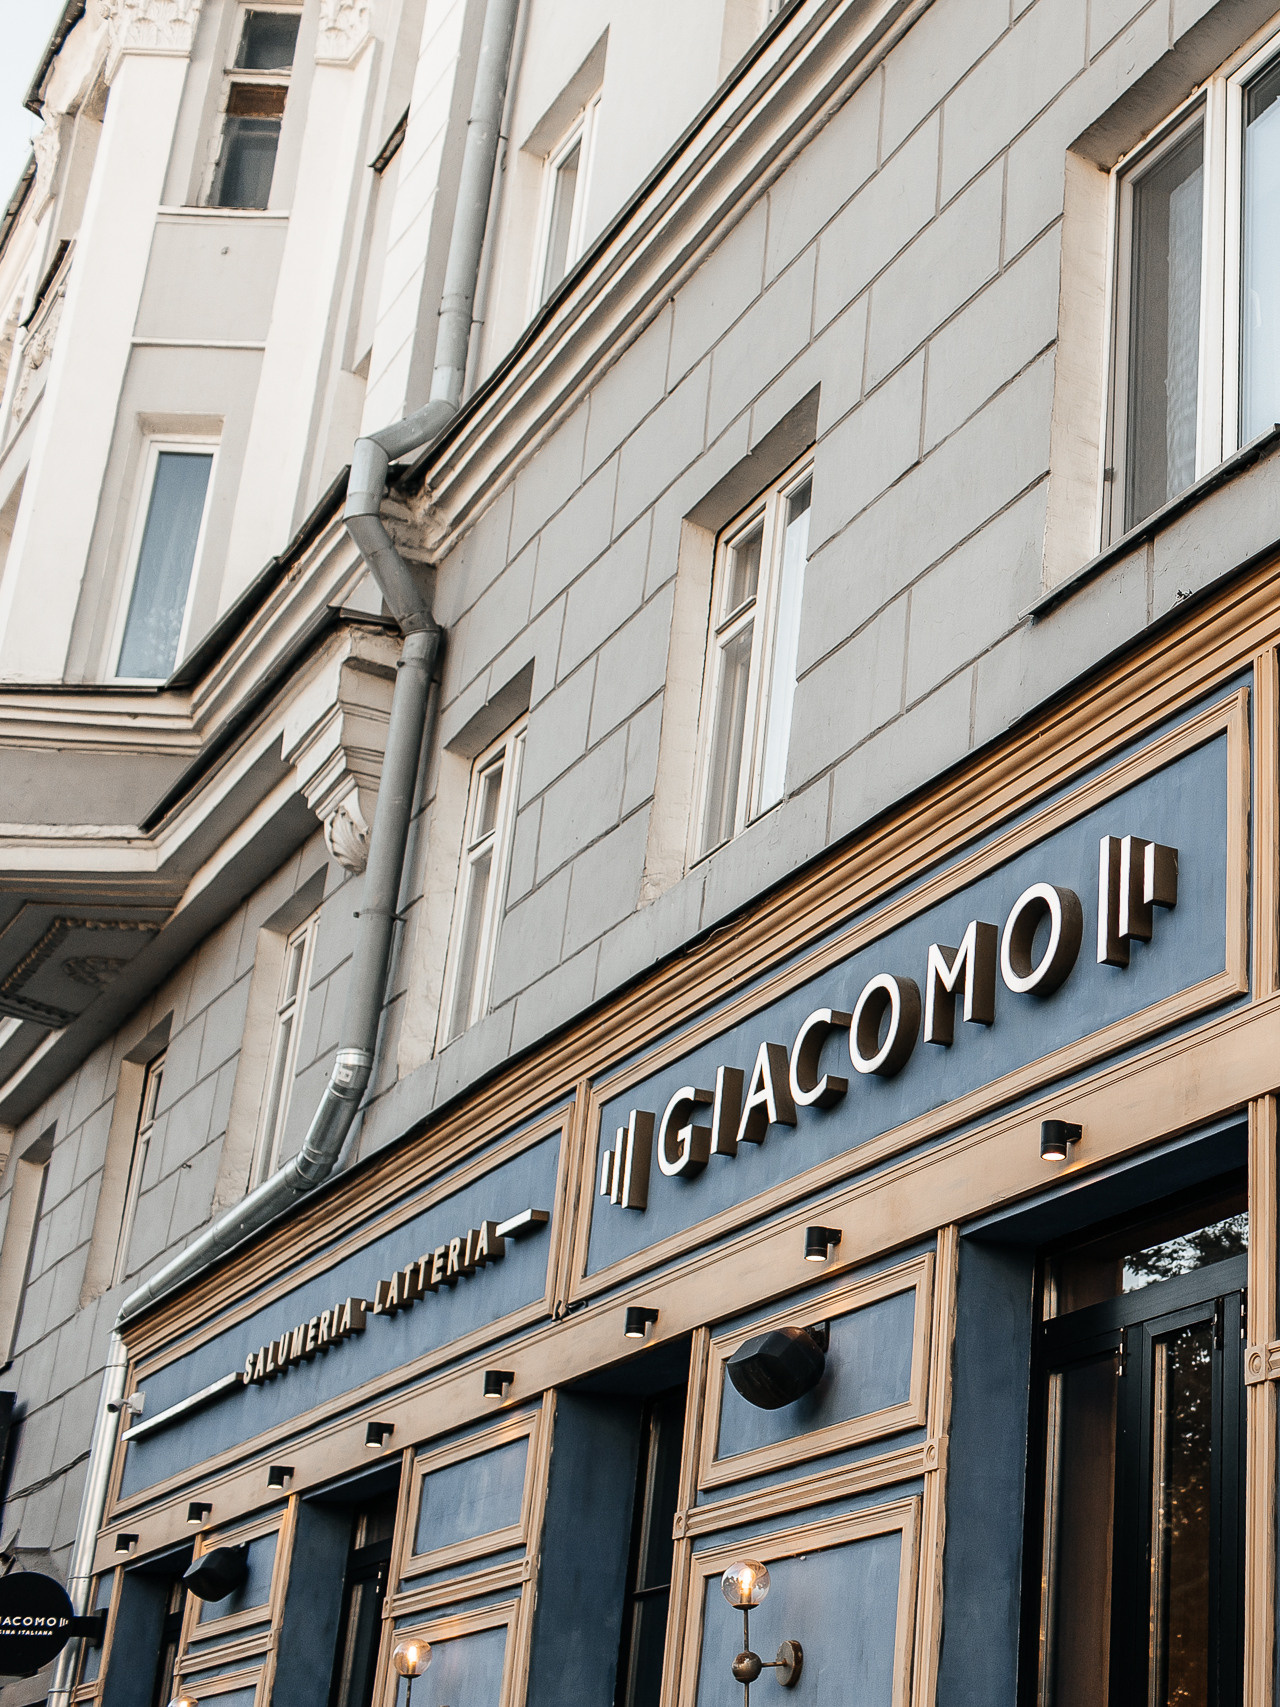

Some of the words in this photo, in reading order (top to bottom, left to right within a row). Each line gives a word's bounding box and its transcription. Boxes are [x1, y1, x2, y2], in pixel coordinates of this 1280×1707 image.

[657, 881, 1070, 1177] GIACOMO
[243, 1297, 358, 1385] SALUMERIA
[373, 1220, 495, 1314] LATTERIA
